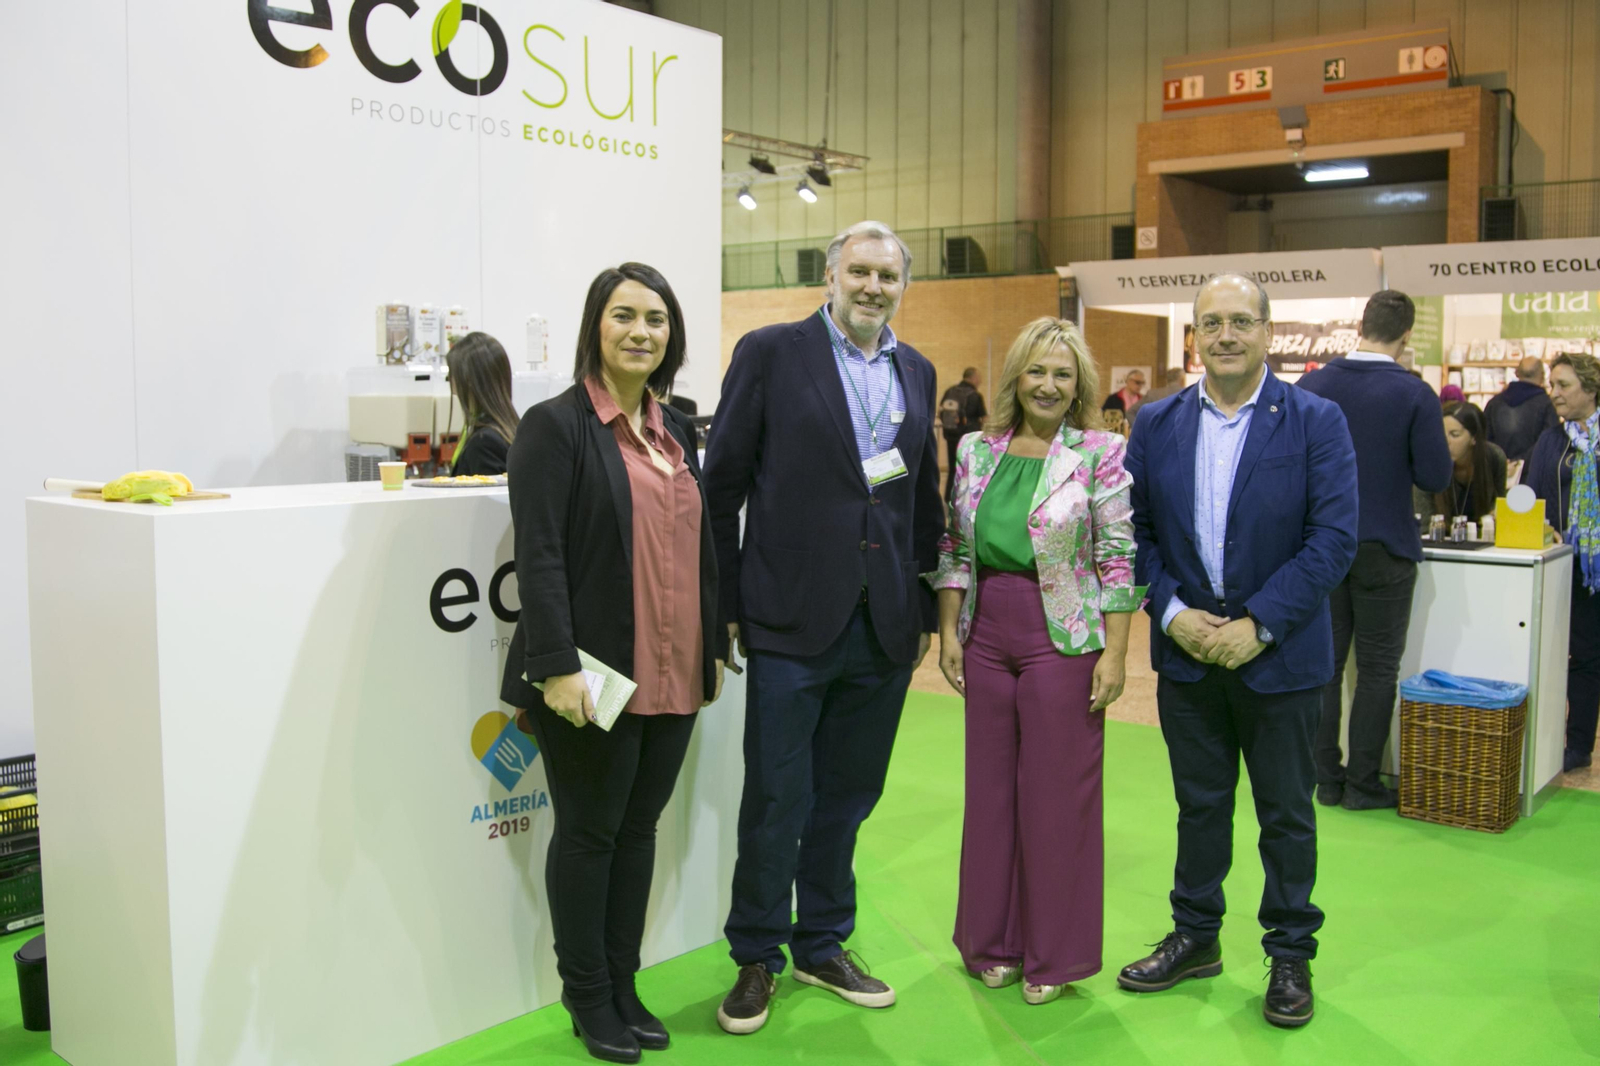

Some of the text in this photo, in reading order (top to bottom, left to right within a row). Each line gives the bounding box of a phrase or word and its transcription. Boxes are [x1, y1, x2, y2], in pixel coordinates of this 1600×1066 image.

[247, 0, 679, 126] ecosur
[351, 98, 659, 160] PRODUCTOS ECOLÓGICOS
[1118, 277, 1135, 288] 71
[1246, 269, 1327, 284] DOLERA
[1430, 258, 1600, 276] 70 CENTRO ECOL
[429, 560, 522, 633] ec
[490, 636, 511, 652] PR
[600, 682, 633, 726] BioCultura
[470, 789, 549, 823] ALMERÍA
[488, 815, 531, 840] 2019
